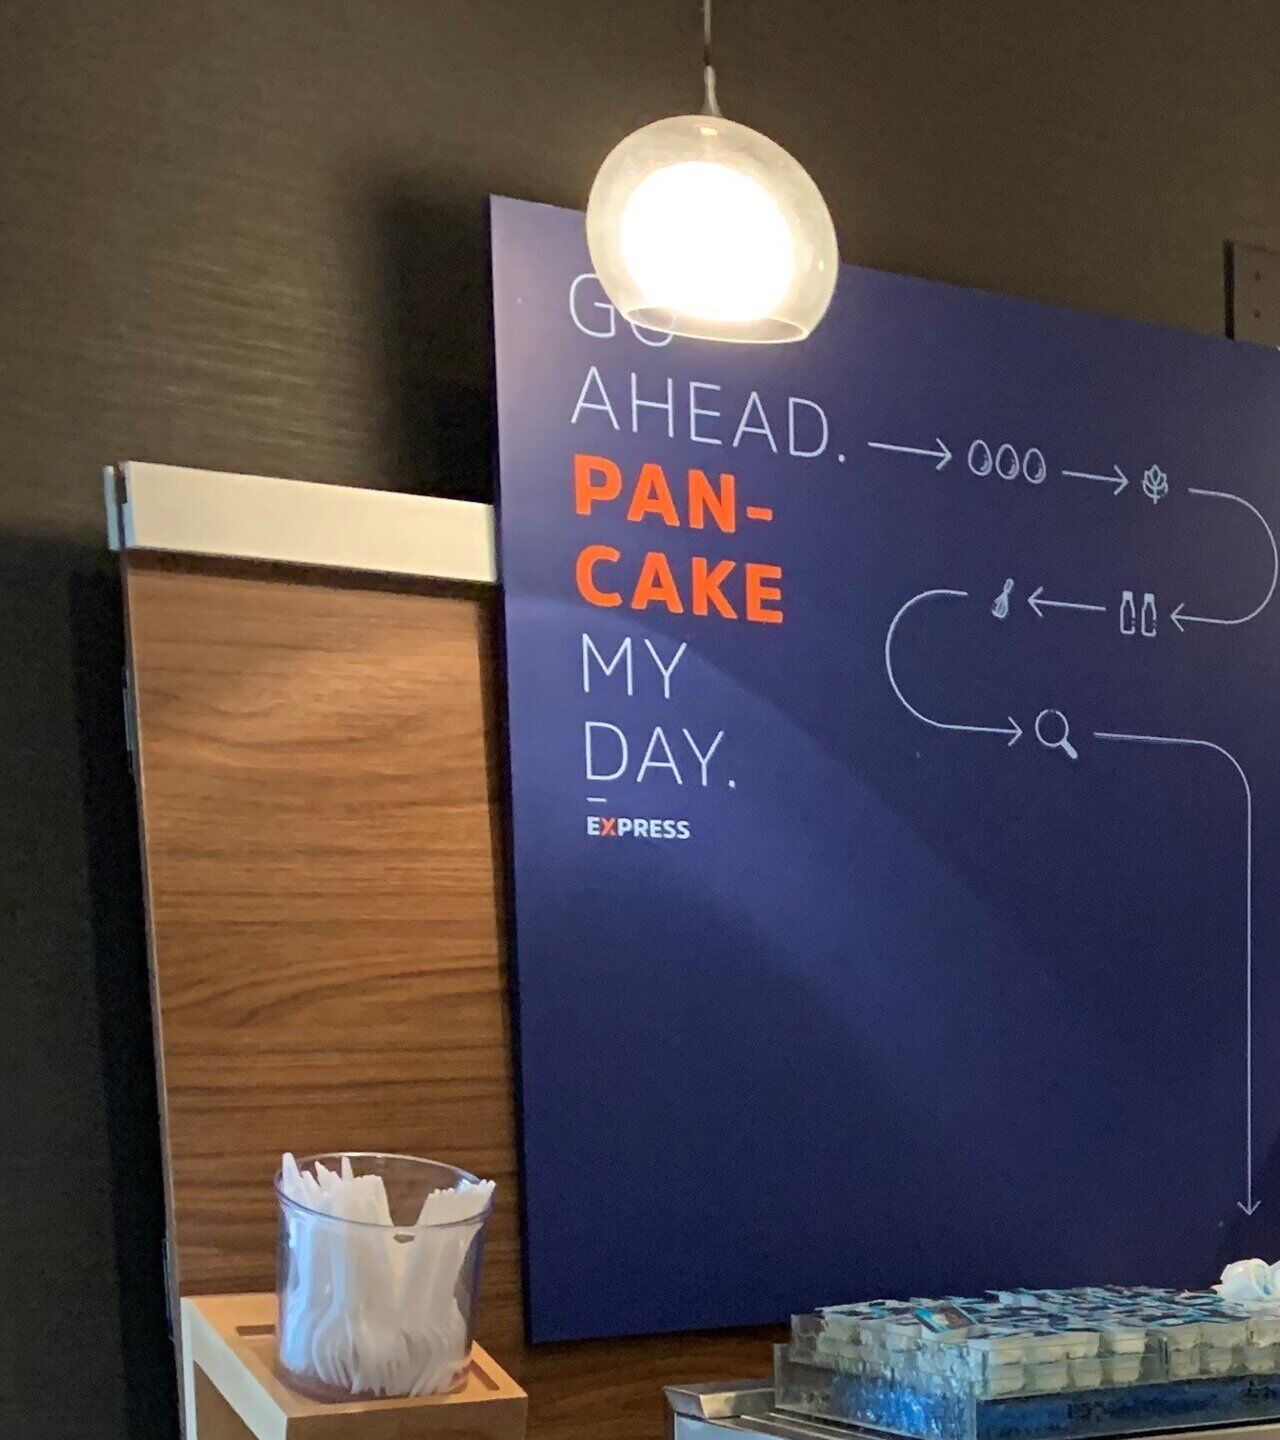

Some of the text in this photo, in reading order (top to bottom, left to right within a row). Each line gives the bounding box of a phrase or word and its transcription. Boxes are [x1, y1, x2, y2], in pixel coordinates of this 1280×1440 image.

[571, 366, 846, 462] AHEAD.
[573, 453, 774, 534] PAN-
[575, 544, 784, 624] CAKE
[582, 633, 688, 699] MY
[583, 721, 737, 790] DAY.
[587, 815, 690, 840] EXPRESS
